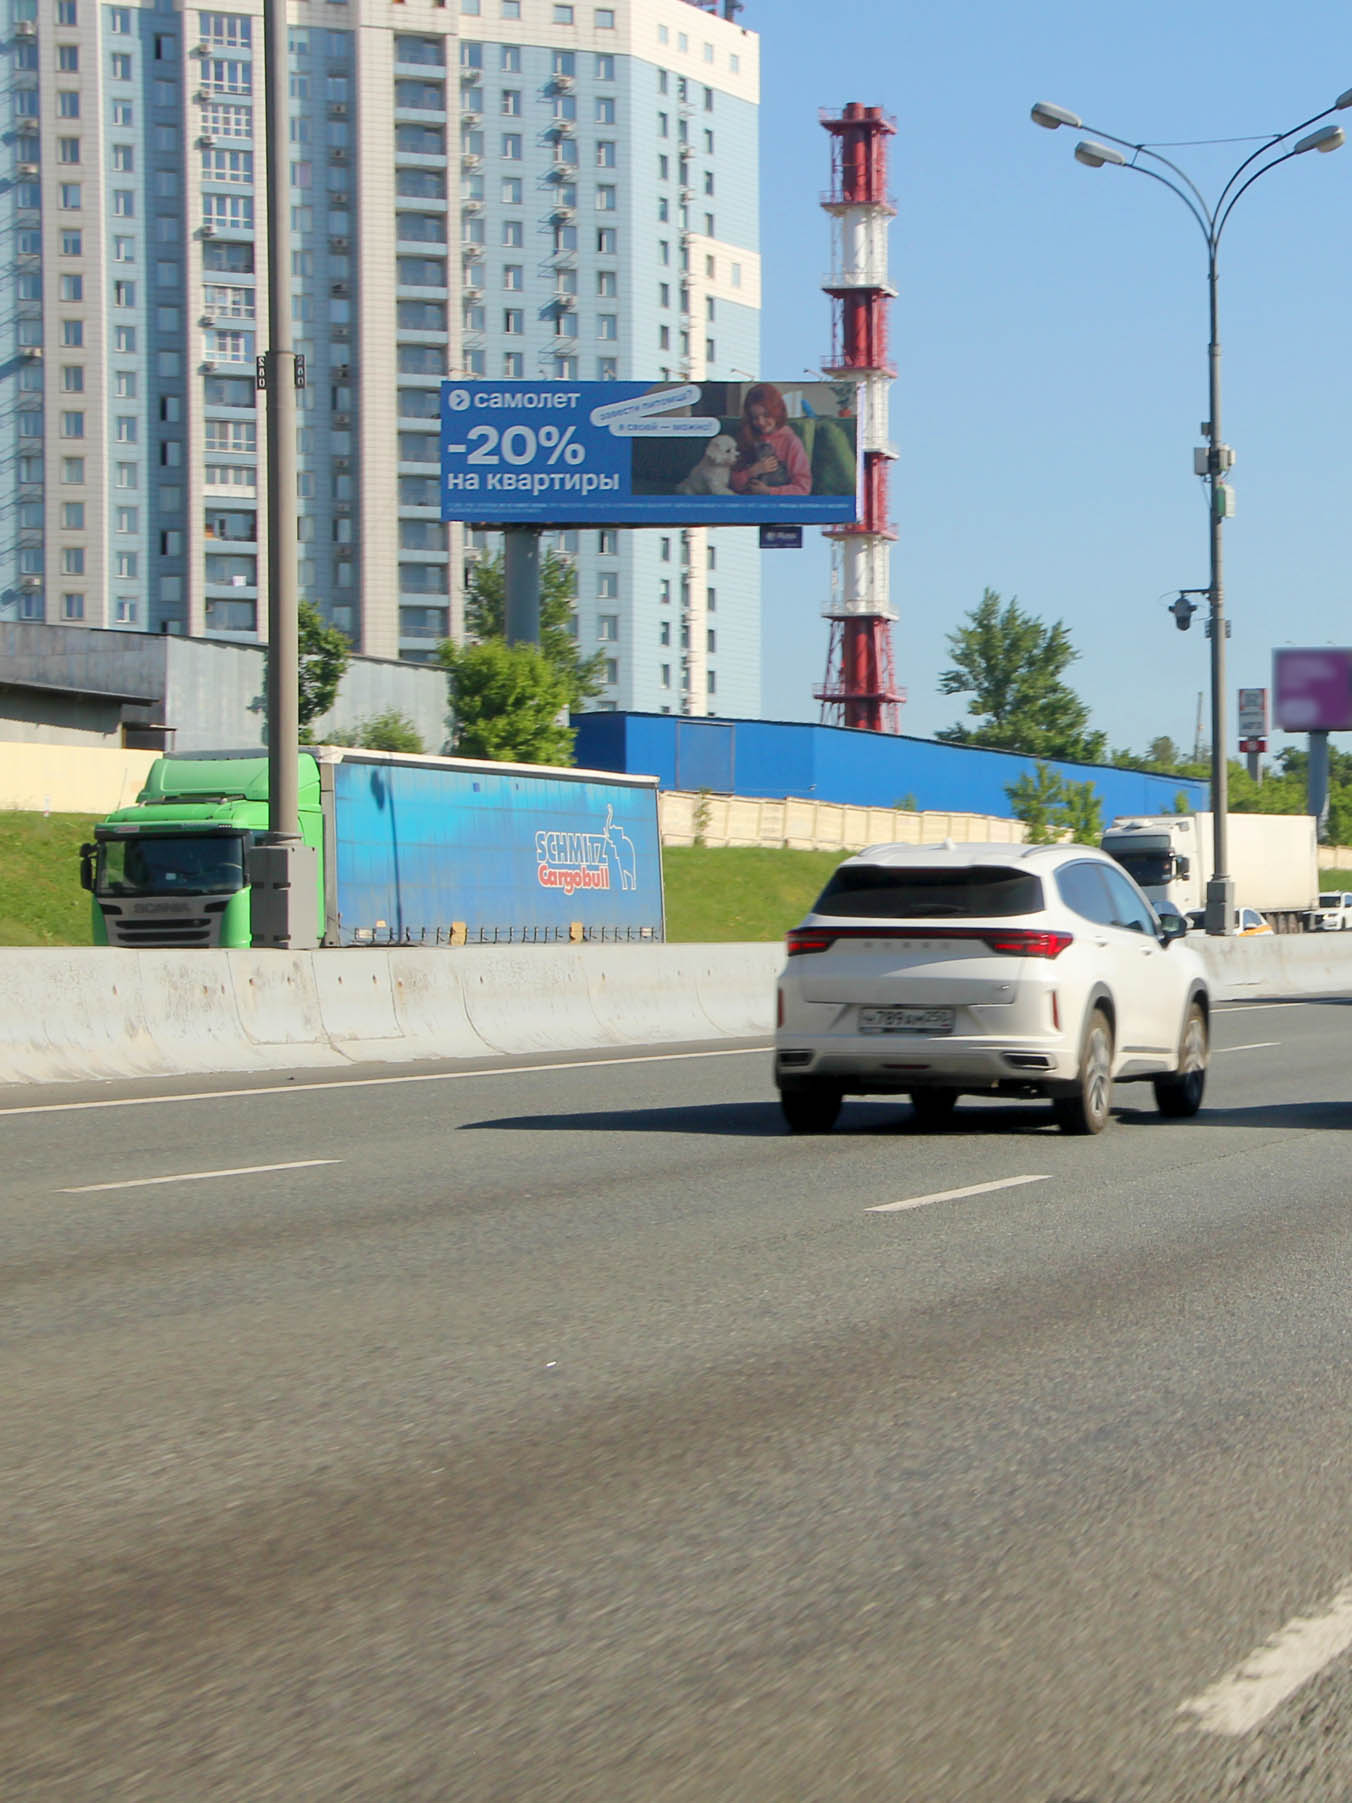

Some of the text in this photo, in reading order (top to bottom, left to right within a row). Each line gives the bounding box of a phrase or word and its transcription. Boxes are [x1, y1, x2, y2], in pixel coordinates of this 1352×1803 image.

[474, 392, 581, 409] самолет
[447, 425, 586, 465] -20%
[447, 473, 621, 496] на квартиры
[535, 830, 609, 866] SCHMITZ
[538, 863, 610, 895] Cargobull
